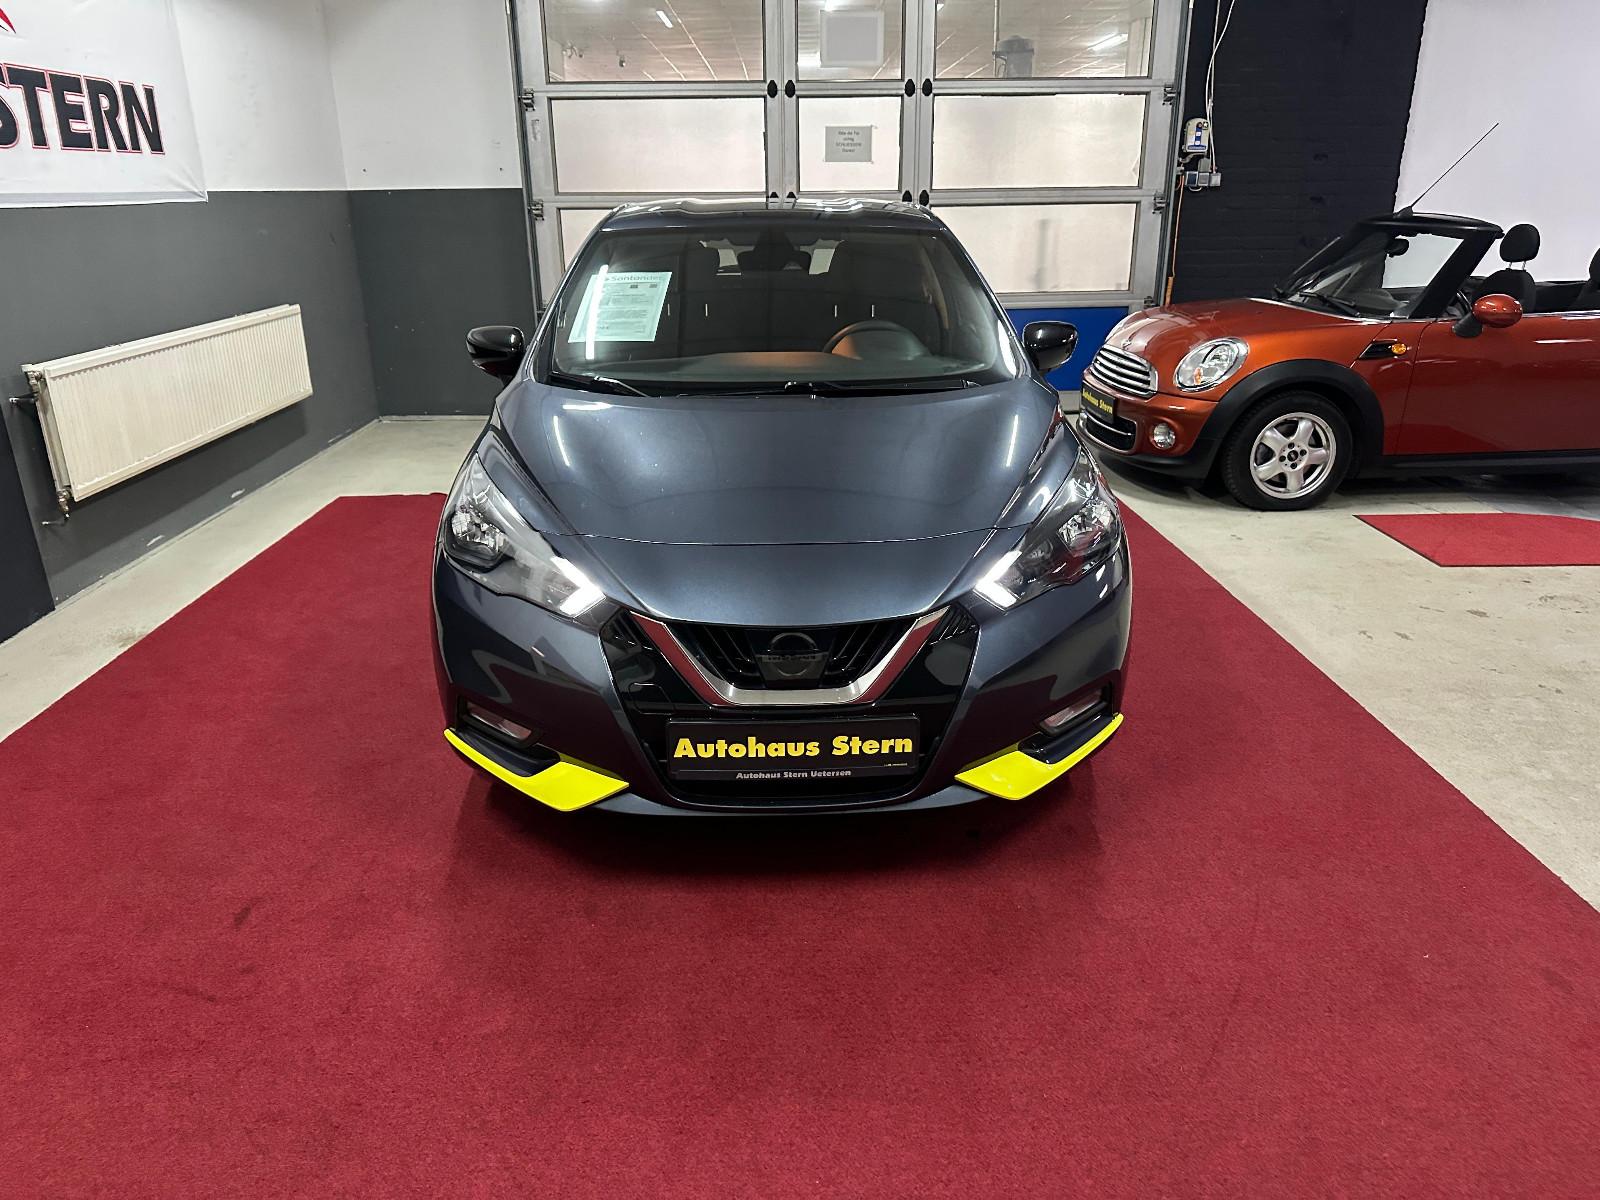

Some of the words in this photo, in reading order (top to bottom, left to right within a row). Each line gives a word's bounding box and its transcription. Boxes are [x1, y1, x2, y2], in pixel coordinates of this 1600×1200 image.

[673, 736, 821, 758] Autohaus
[831, 735, 913, 756] Stern
[735, 771, 782, 779] Autohaus
[783, 770, 808, 778] Stern
[810, 769, 852, 778] Uetersen
